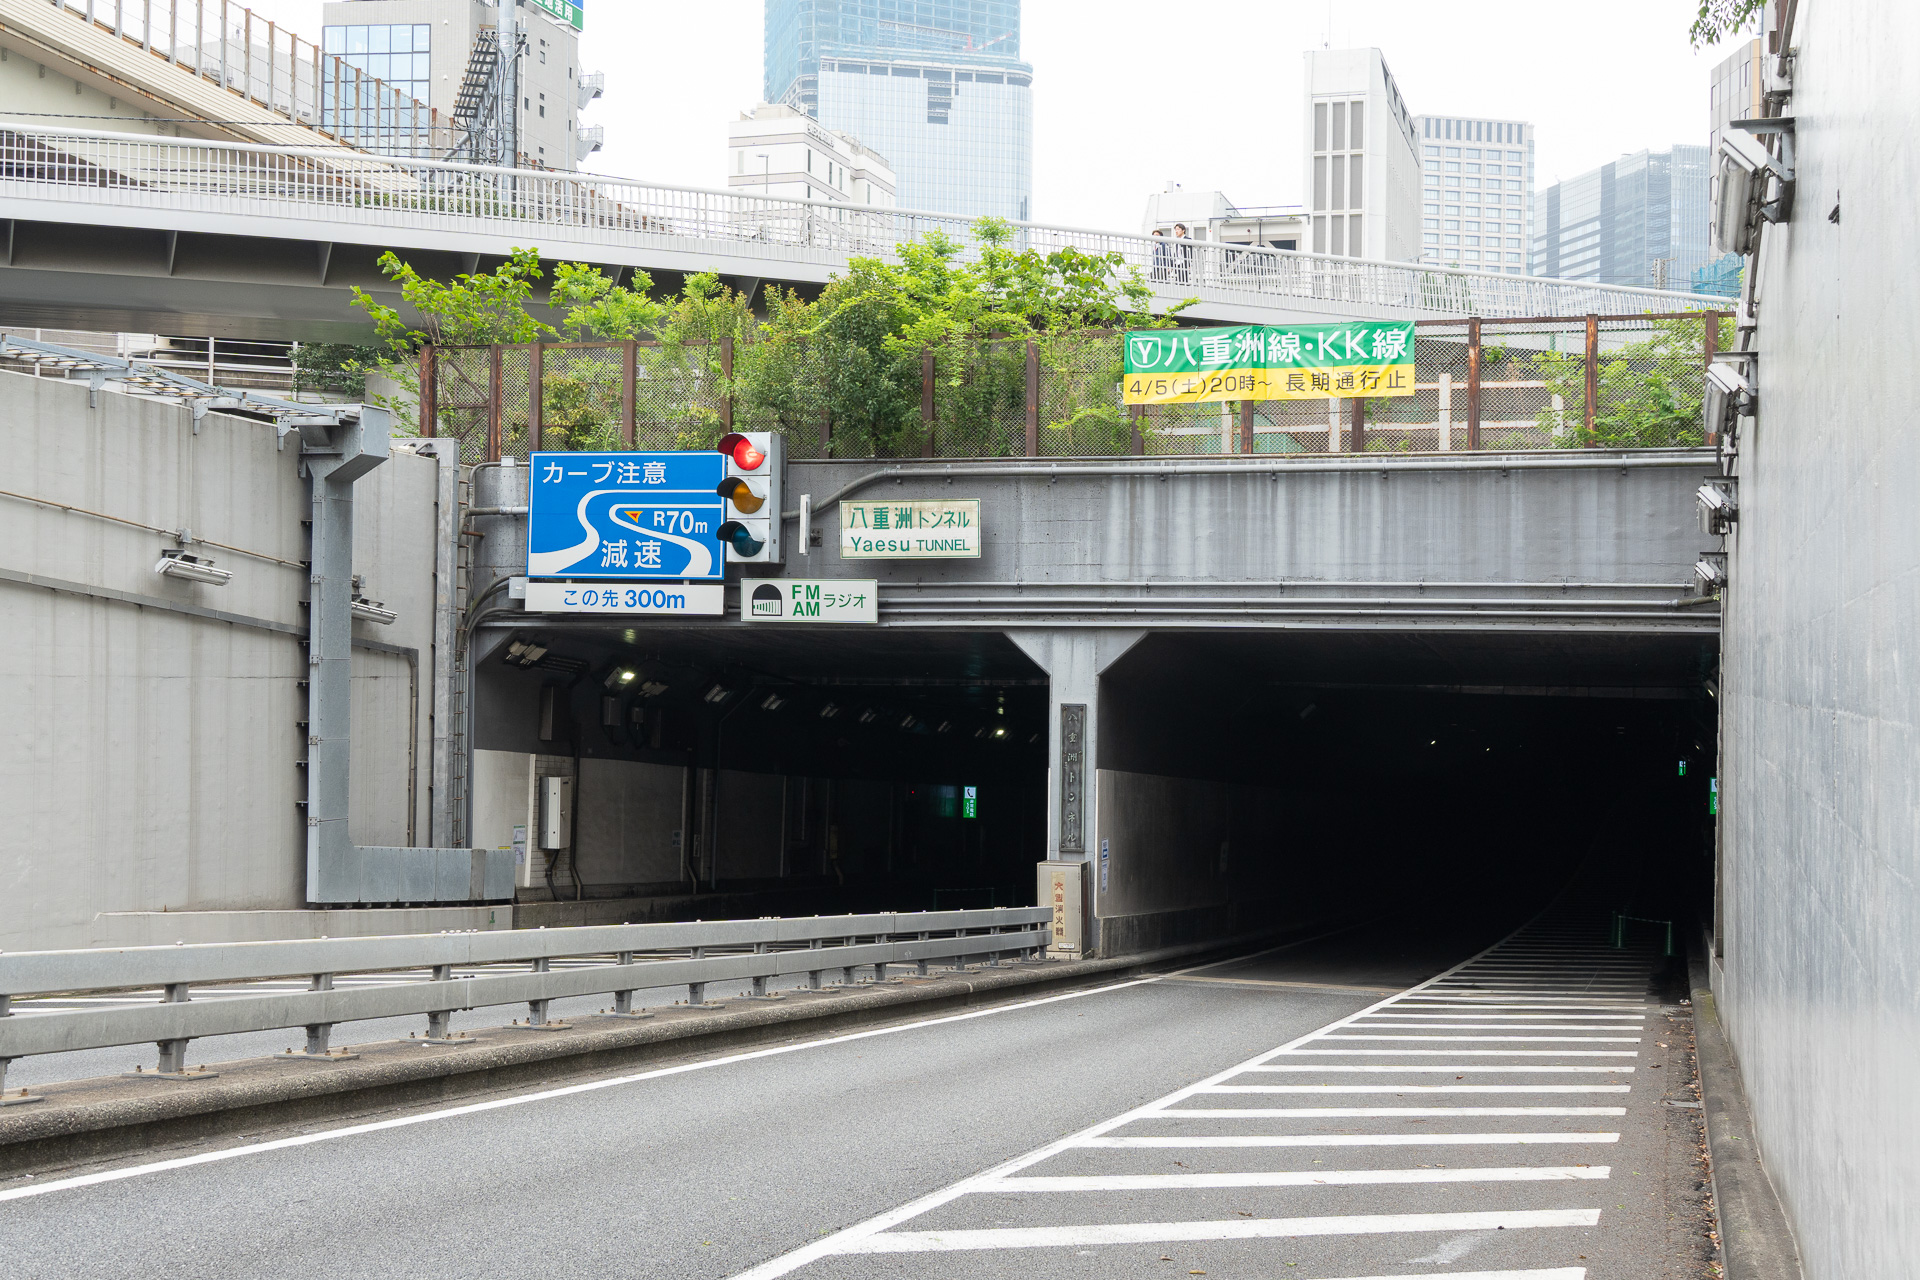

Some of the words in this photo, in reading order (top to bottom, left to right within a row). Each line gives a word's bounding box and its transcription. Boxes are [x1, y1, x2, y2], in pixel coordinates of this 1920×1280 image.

[1164, 328, 1407, 367] 八重洲線・KK線
[1286, 370, 1406, 392] 長期通行止
[542, 461, 667, 485] カーブ注意
[653, 510, 708, 534] R70m
[600, 539, 662, 569] 減速
[850, 536, 910, 552] Yaesu
[916, 539, 971, 552] TUNNEL
[792, 584, 820, 600] FM
[823, 593, 867, 609] ラジオ
[792, 601, 820, 617] AM
[1067, 713, 1078, 842] 八重洲トンネル
